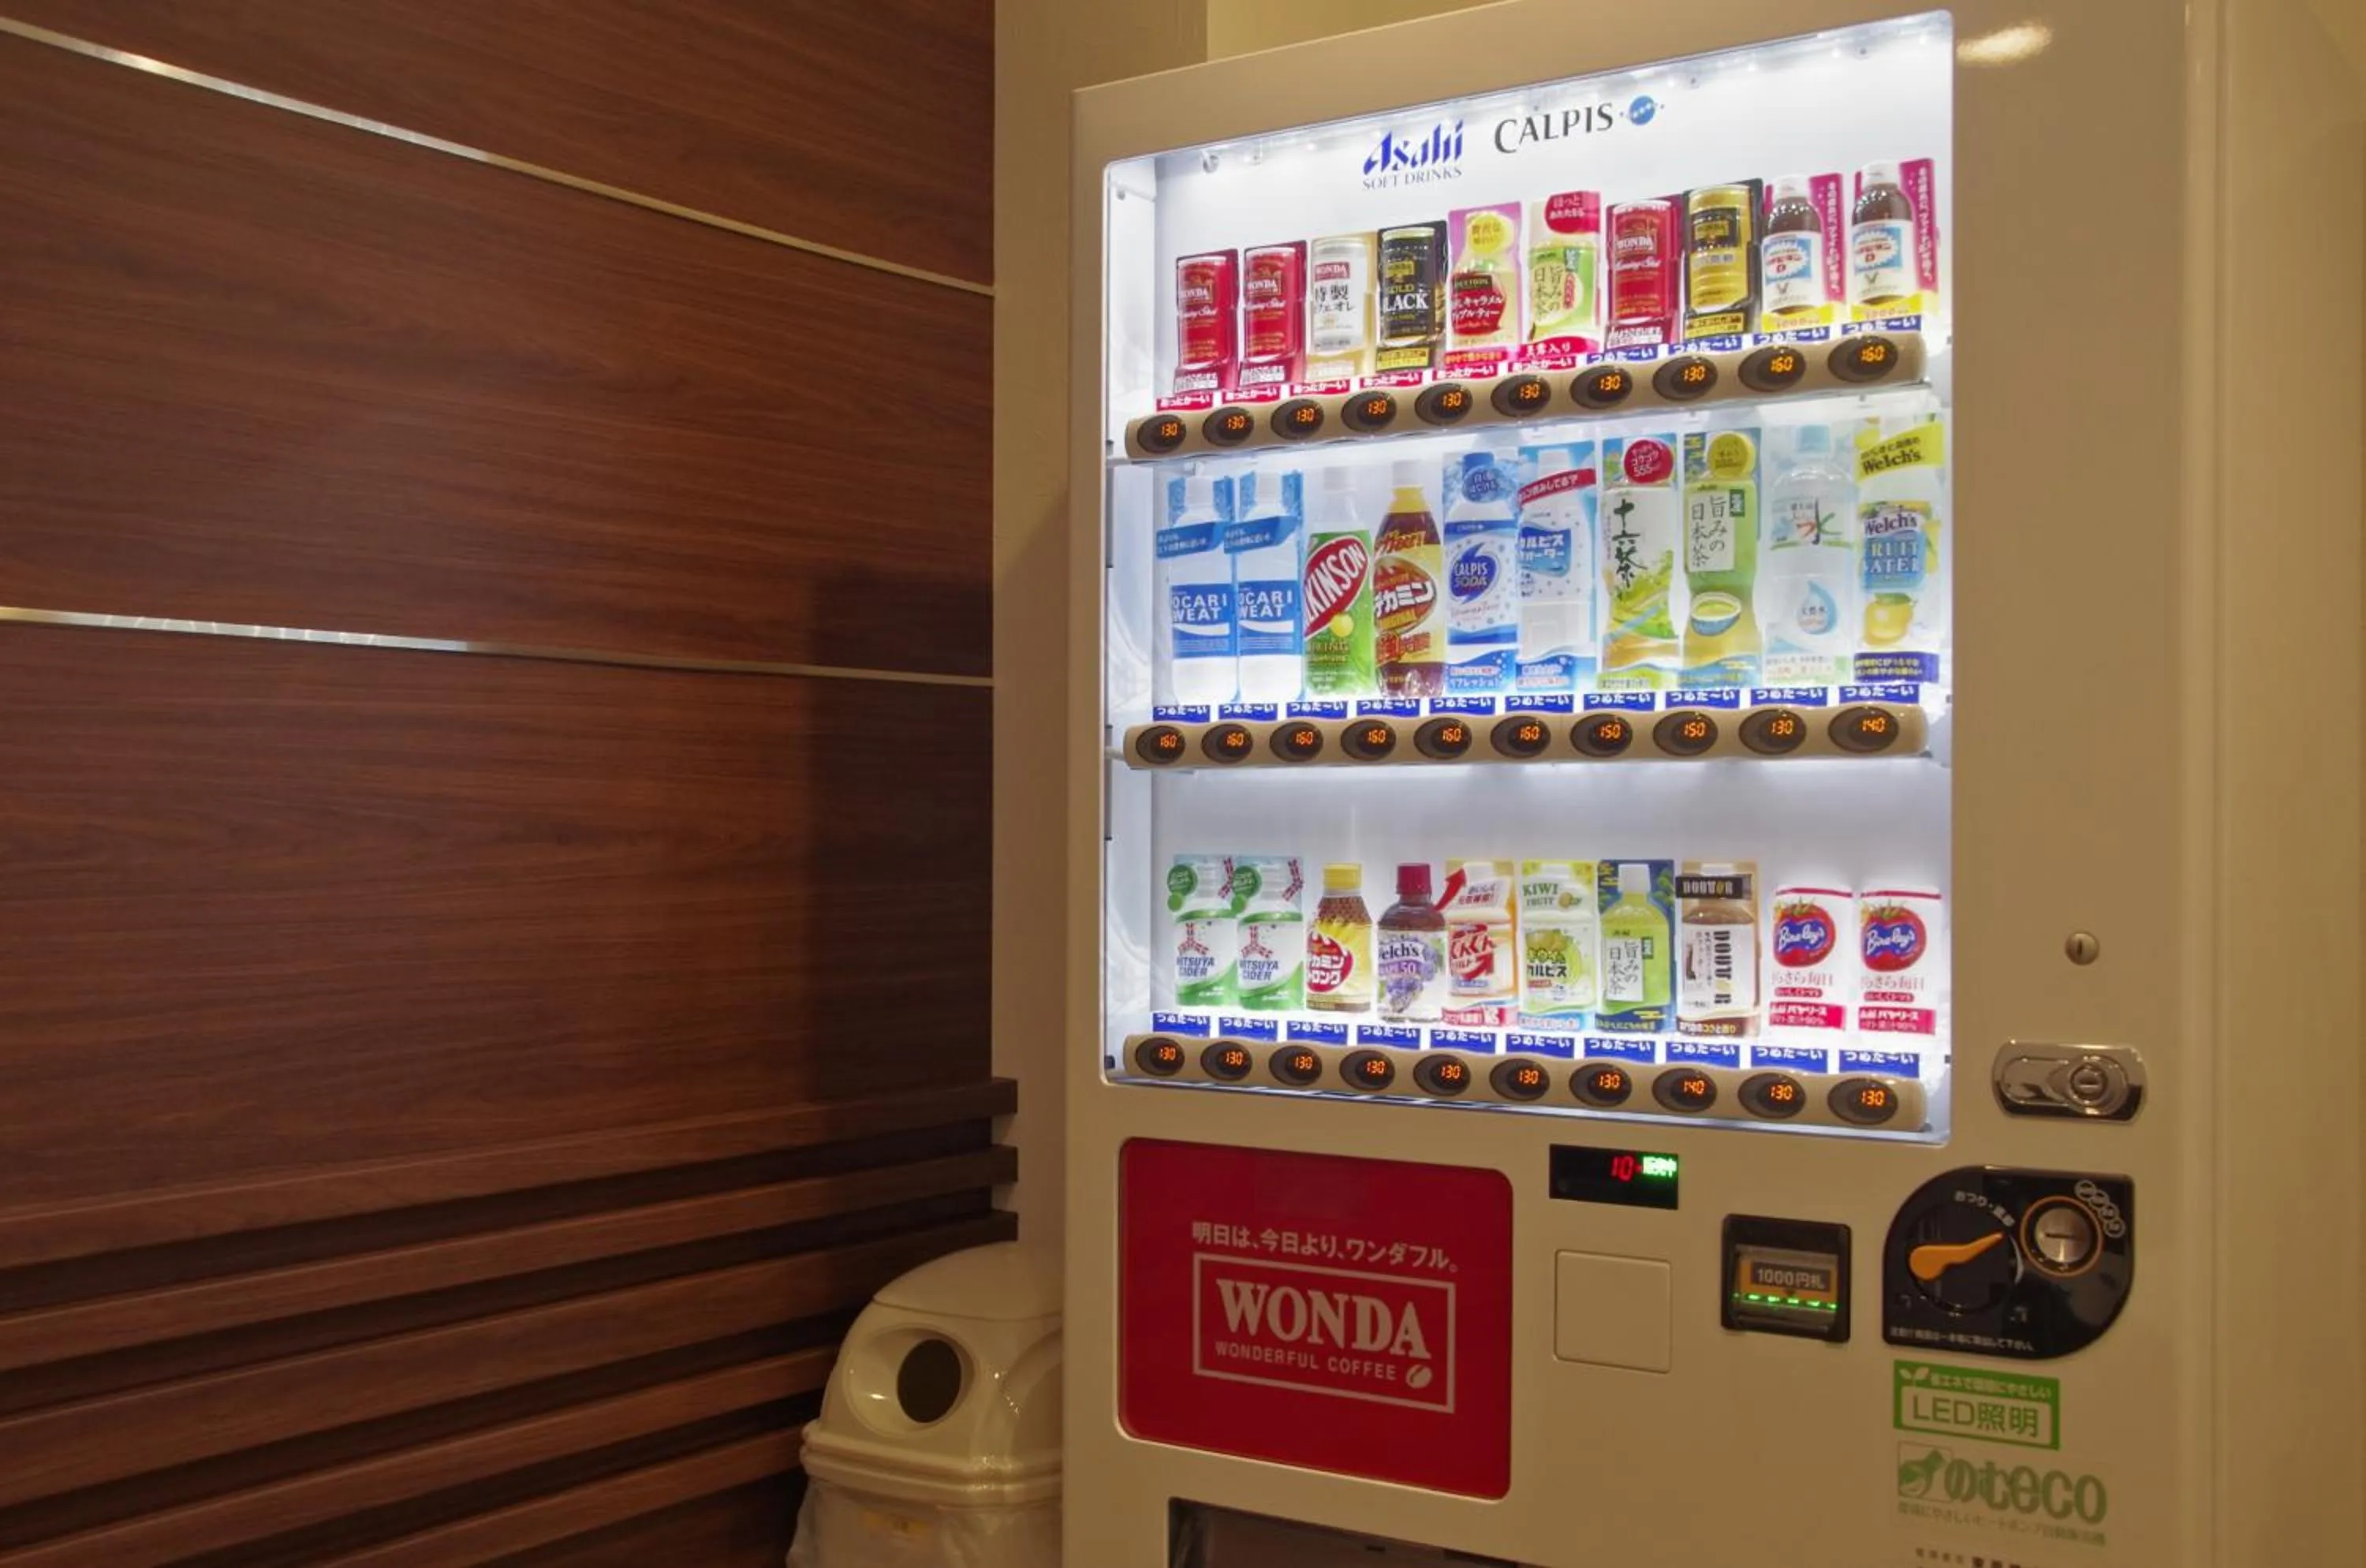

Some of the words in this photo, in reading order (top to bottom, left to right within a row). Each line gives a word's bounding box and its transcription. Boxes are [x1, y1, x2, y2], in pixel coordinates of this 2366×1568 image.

[1494, 102, 1614, 155] CALPIS
[1363, 120, 1464, 175] Asahi
[1362, 176, 1399, 191] SOFT
[1403, 166, 1462, 186] DRINKS
[1383, 292, 1429, 312] LACK
[1861, 345, 1885, 363] 160
[1771, 355, 1794, 372] 160
[1684, 365, 1706, 381] 130
[1521, 383, 1539, 399] 130
[1600, 375, 1621, 391] 130
[1369, 400, 1386, 414] 130
[1443, 392, 1462, 408] 130
[1228, 416, 1245, 430] 130
[1297, 409, 1315, 422] 130
[1162, 423, 1177, 436] 130
[1861, 449, 1923, 475] Welch's
[1864, 510, 1919, 536] Welch's
[1871, 541, 1920, 557] RUIT
[1173, 592, 1227, 608] OCARI
[1239, 589, 1293, 607] OCARI
[1173, 607, 1222, 622] WEAT
[1239, 604, 1285, 619] WEAT
[1600, 723, 1621, 739] 150
[1684, 722, 1706, 737] 150
[1771, 719, 1793, 734] 130
[1861, 716, 1886, 734] 140
[1160, 734, 1177, 748] 160
[1226, 733, 1245, 746] 160
[1296, 730, 1314, 745] 160
[1368, 729, 1386, 743] 160
[1442, 727, 1462, 742] 160
[1520, 726, 1540, 741] 160
[1522, 882, 1559, 897] KIWI
[1379, 942, 1420, 960] elch's
[1159, 1046, 1177, 1060] 130
[1226, 1051, 1244, 1065] 130
[1295, 1055, 1314, 1069] 130
[1367, 1060, 1386, 1074] 130
[1441, 1064, 1461, 1079] 130
[1519, 1069, 1539, 1085] 130
[1599, 1073, 1621, 1089] 130
[1684, 1079, 1705, 1095] 140
[1771, 1085, 1793, 1100] 130
[1861, 1089, 1886, 1107] 130
[1216, 1278, 1433, 1360] WONDA
[1215, 1340, 1320, 1370] WONDERFUL
[1327, 1357, 1398, 1381] COFFEE
[1913, 1394, 2039, 1439] LED照明
